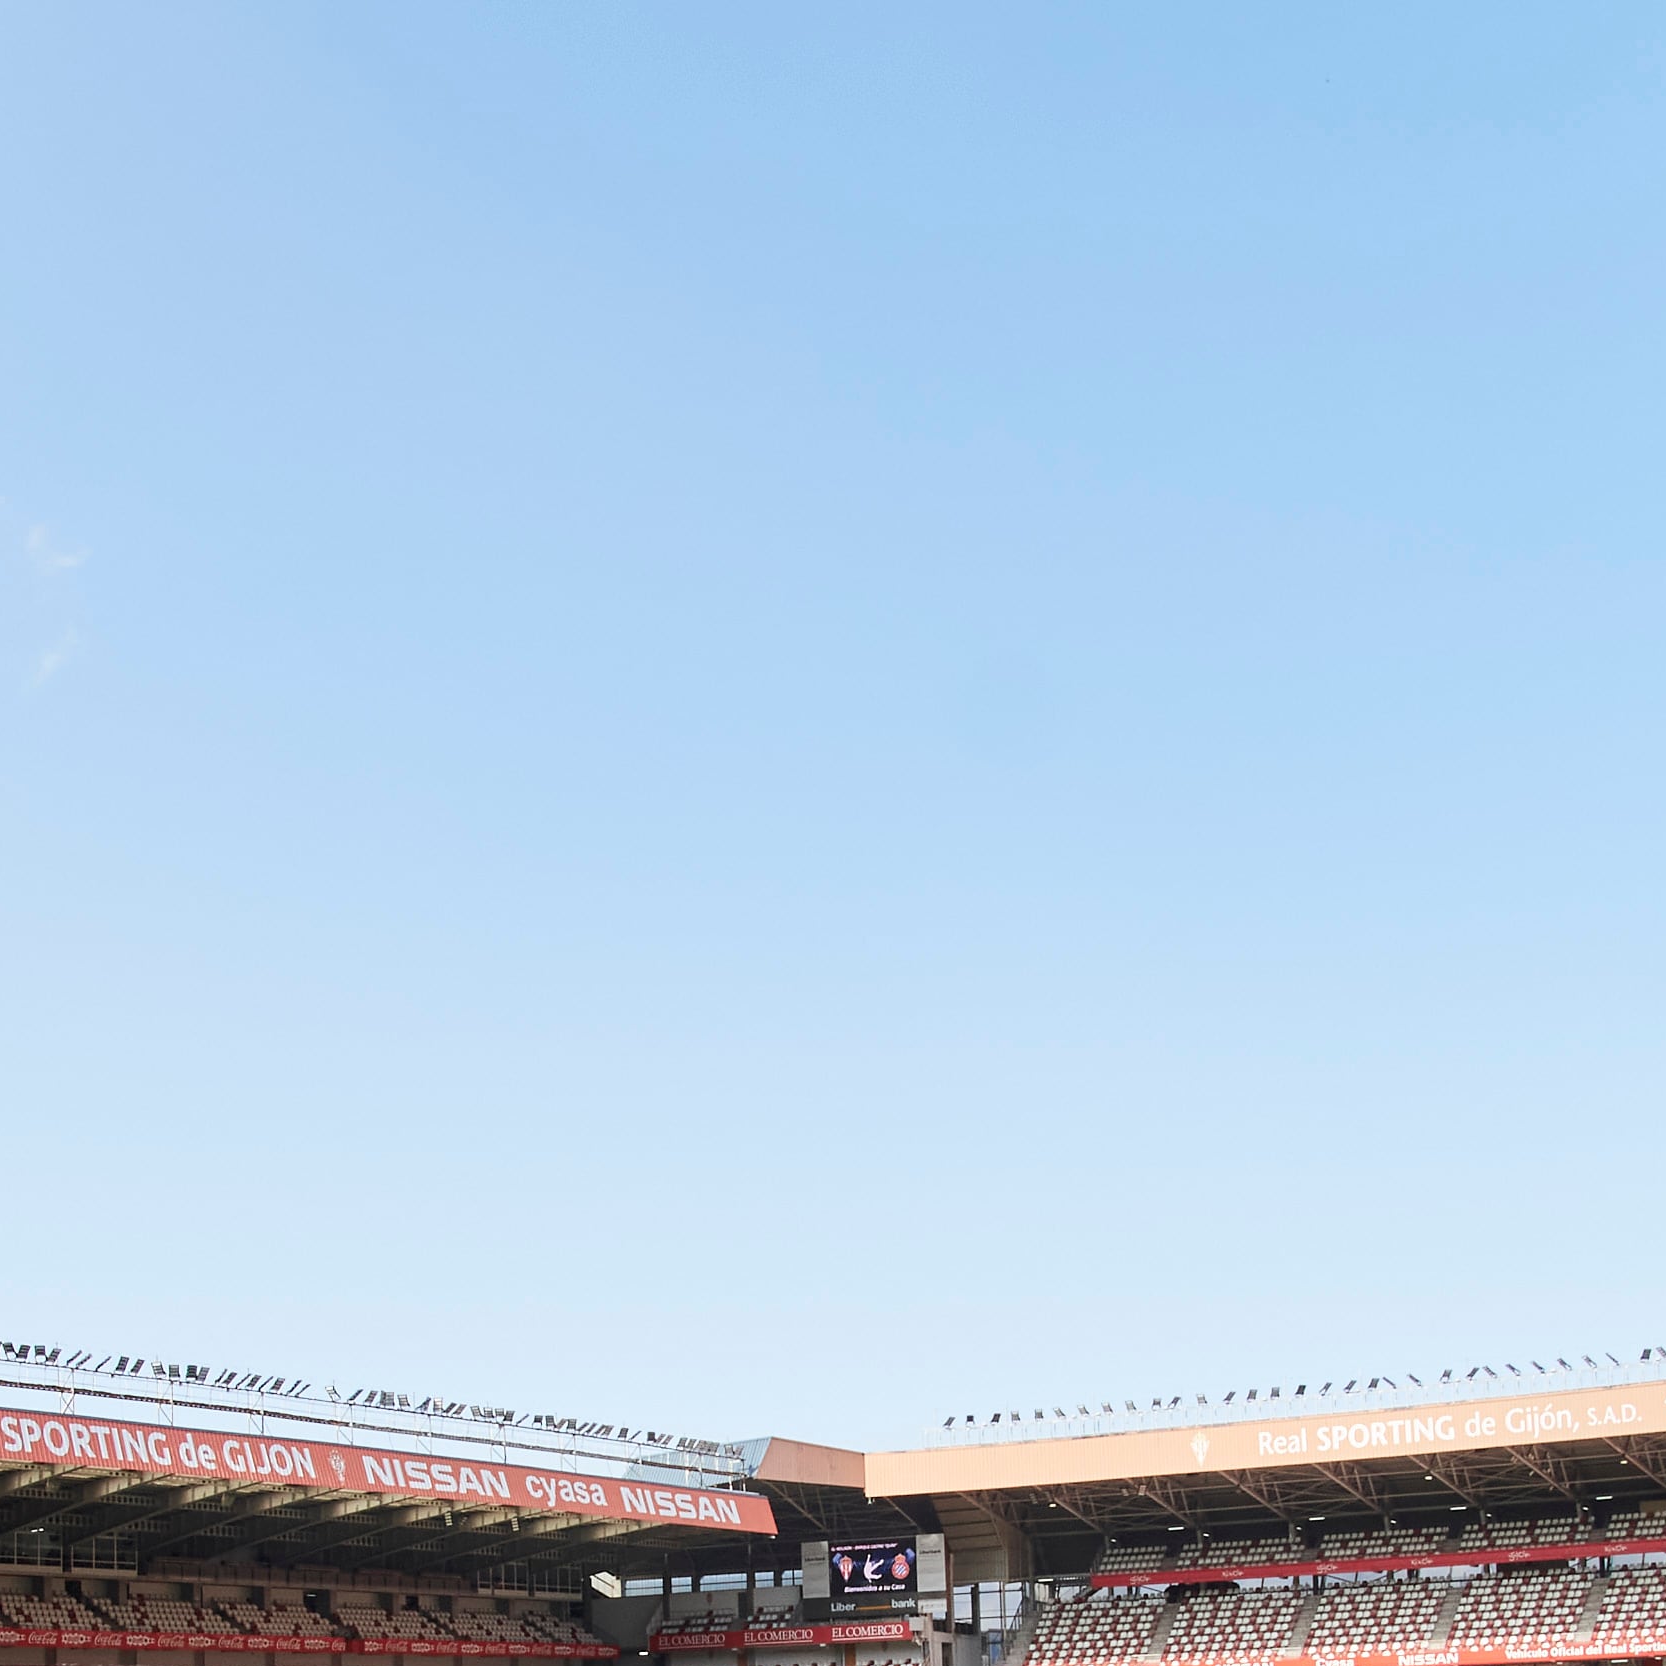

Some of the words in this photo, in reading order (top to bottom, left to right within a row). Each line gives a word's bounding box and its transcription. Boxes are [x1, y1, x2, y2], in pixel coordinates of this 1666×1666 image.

[1258, 1428, 1307, 1457] Real
[1316, 1415, 1455, 1453] SPORTING
[1464, 1411, 1496, 1438] de
[1505, 1401, 1580, 1440] Gijón,
[1587, 1403, 1643, 1428] S.A.D.
[2, 1416, 168, 1466] SPORTING
[182, 1432, 216, 1472] de
[363, 1453, 510, 1499] NISSAN
[526, 1473, 607, 1508] cyasa
[620, 1485, 741, 1525] NISSAN
[891, 1583, 905, 1591] Casa
[831, 1602, 856, 1612] Liber
[891, 1598, 916, 1609] bank
[744, 1632, 757, 1642] EL
[758, 1629, 813, 1641] COMERCIO
[832, 1628, 844, 1638] EL
[845, 1624, 903, 1637] COMERCIO
[659, 1637, 671, 1646] EL
[672, 1634, 725, 1645] COMERCIO
[1550, 1647, 1583, 1656] Oficial
[1585, 1645, 1602, 1654] del
[1604, 1645, 1627, 1654] Real
[1398, 1653, 1458, 1666] NISSAN
